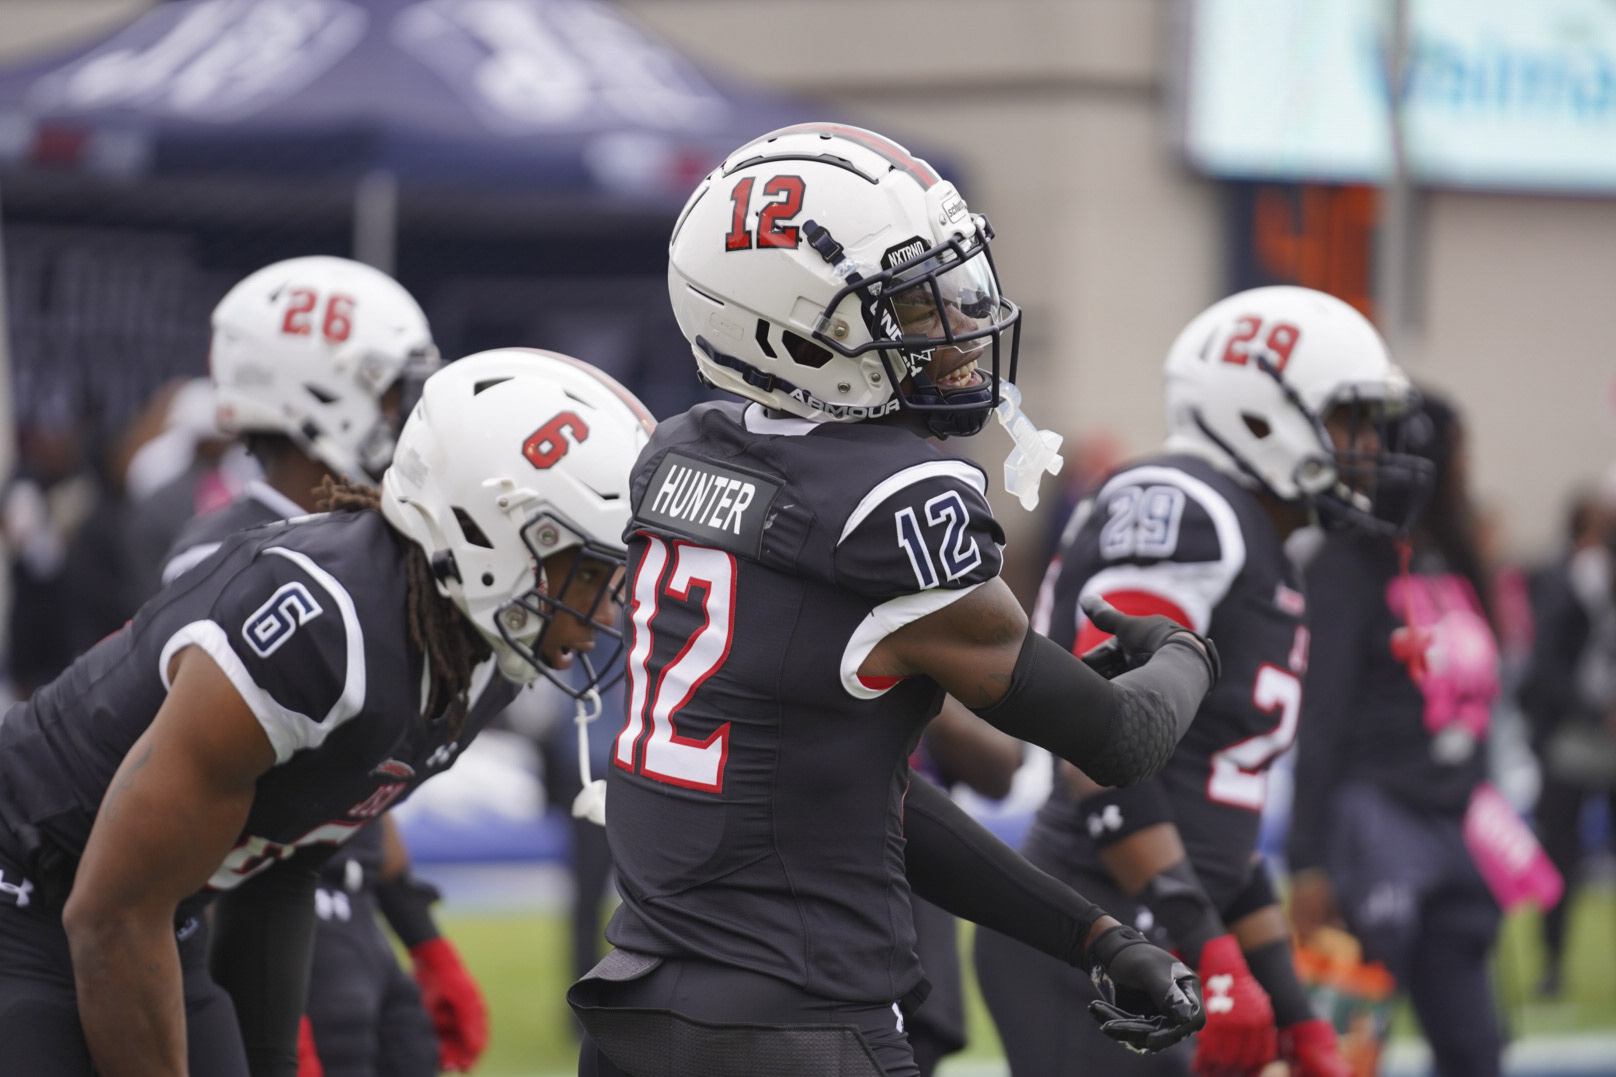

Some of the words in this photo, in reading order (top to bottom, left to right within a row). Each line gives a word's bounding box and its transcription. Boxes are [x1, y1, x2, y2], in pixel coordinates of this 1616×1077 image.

[725, 174, 806, 252] 12
[887, 240, 925, 268] NXTRND
[281, 288, 357, 343] 26
[1221, 315, 1300, 373] 29
[788, 388, 901, 418] ARMOUR
[522, 411, 589, 470] 6
[651, 463, 756, 535] HUNTER
[1100, 484, 1185, 561] 29
[894, 489, 983, 590] 12
[241, 580, 324, 659] 6
[613, 529, 738, 795] 12
